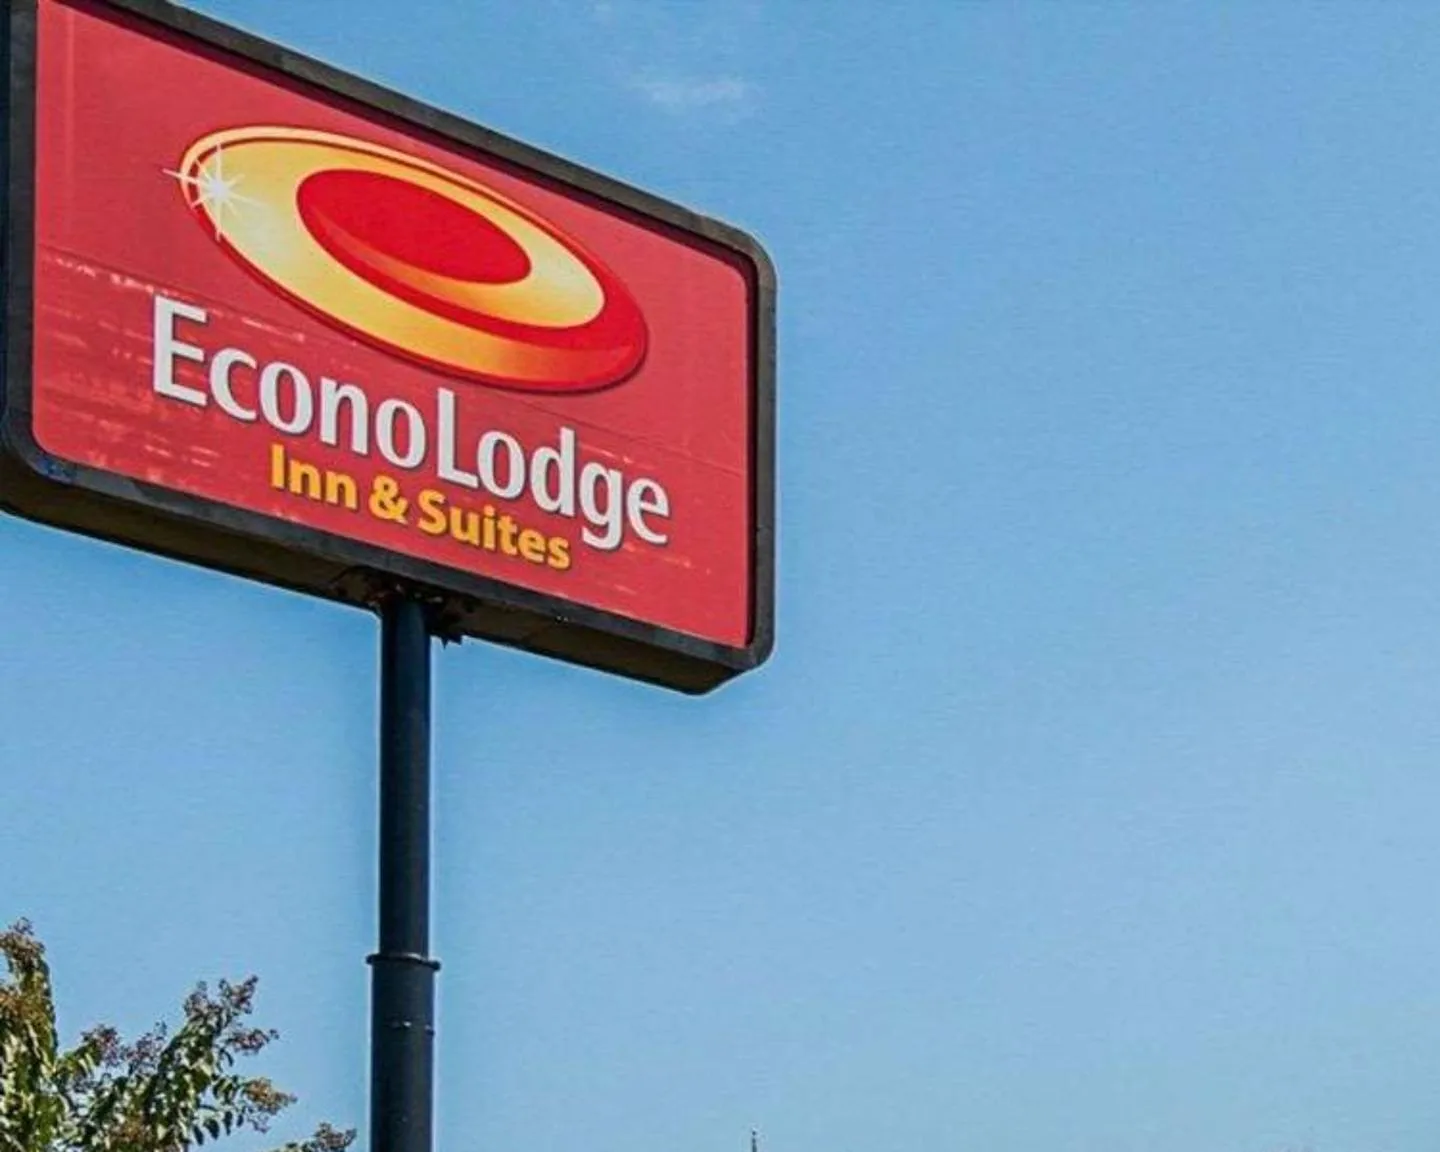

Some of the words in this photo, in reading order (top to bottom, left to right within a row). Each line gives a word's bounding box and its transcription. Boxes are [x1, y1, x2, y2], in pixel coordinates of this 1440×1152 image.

[270, 445, 357, 509] Inn
[369, 475, 408, 524] &
[418, 490, 571, 569] Suites
